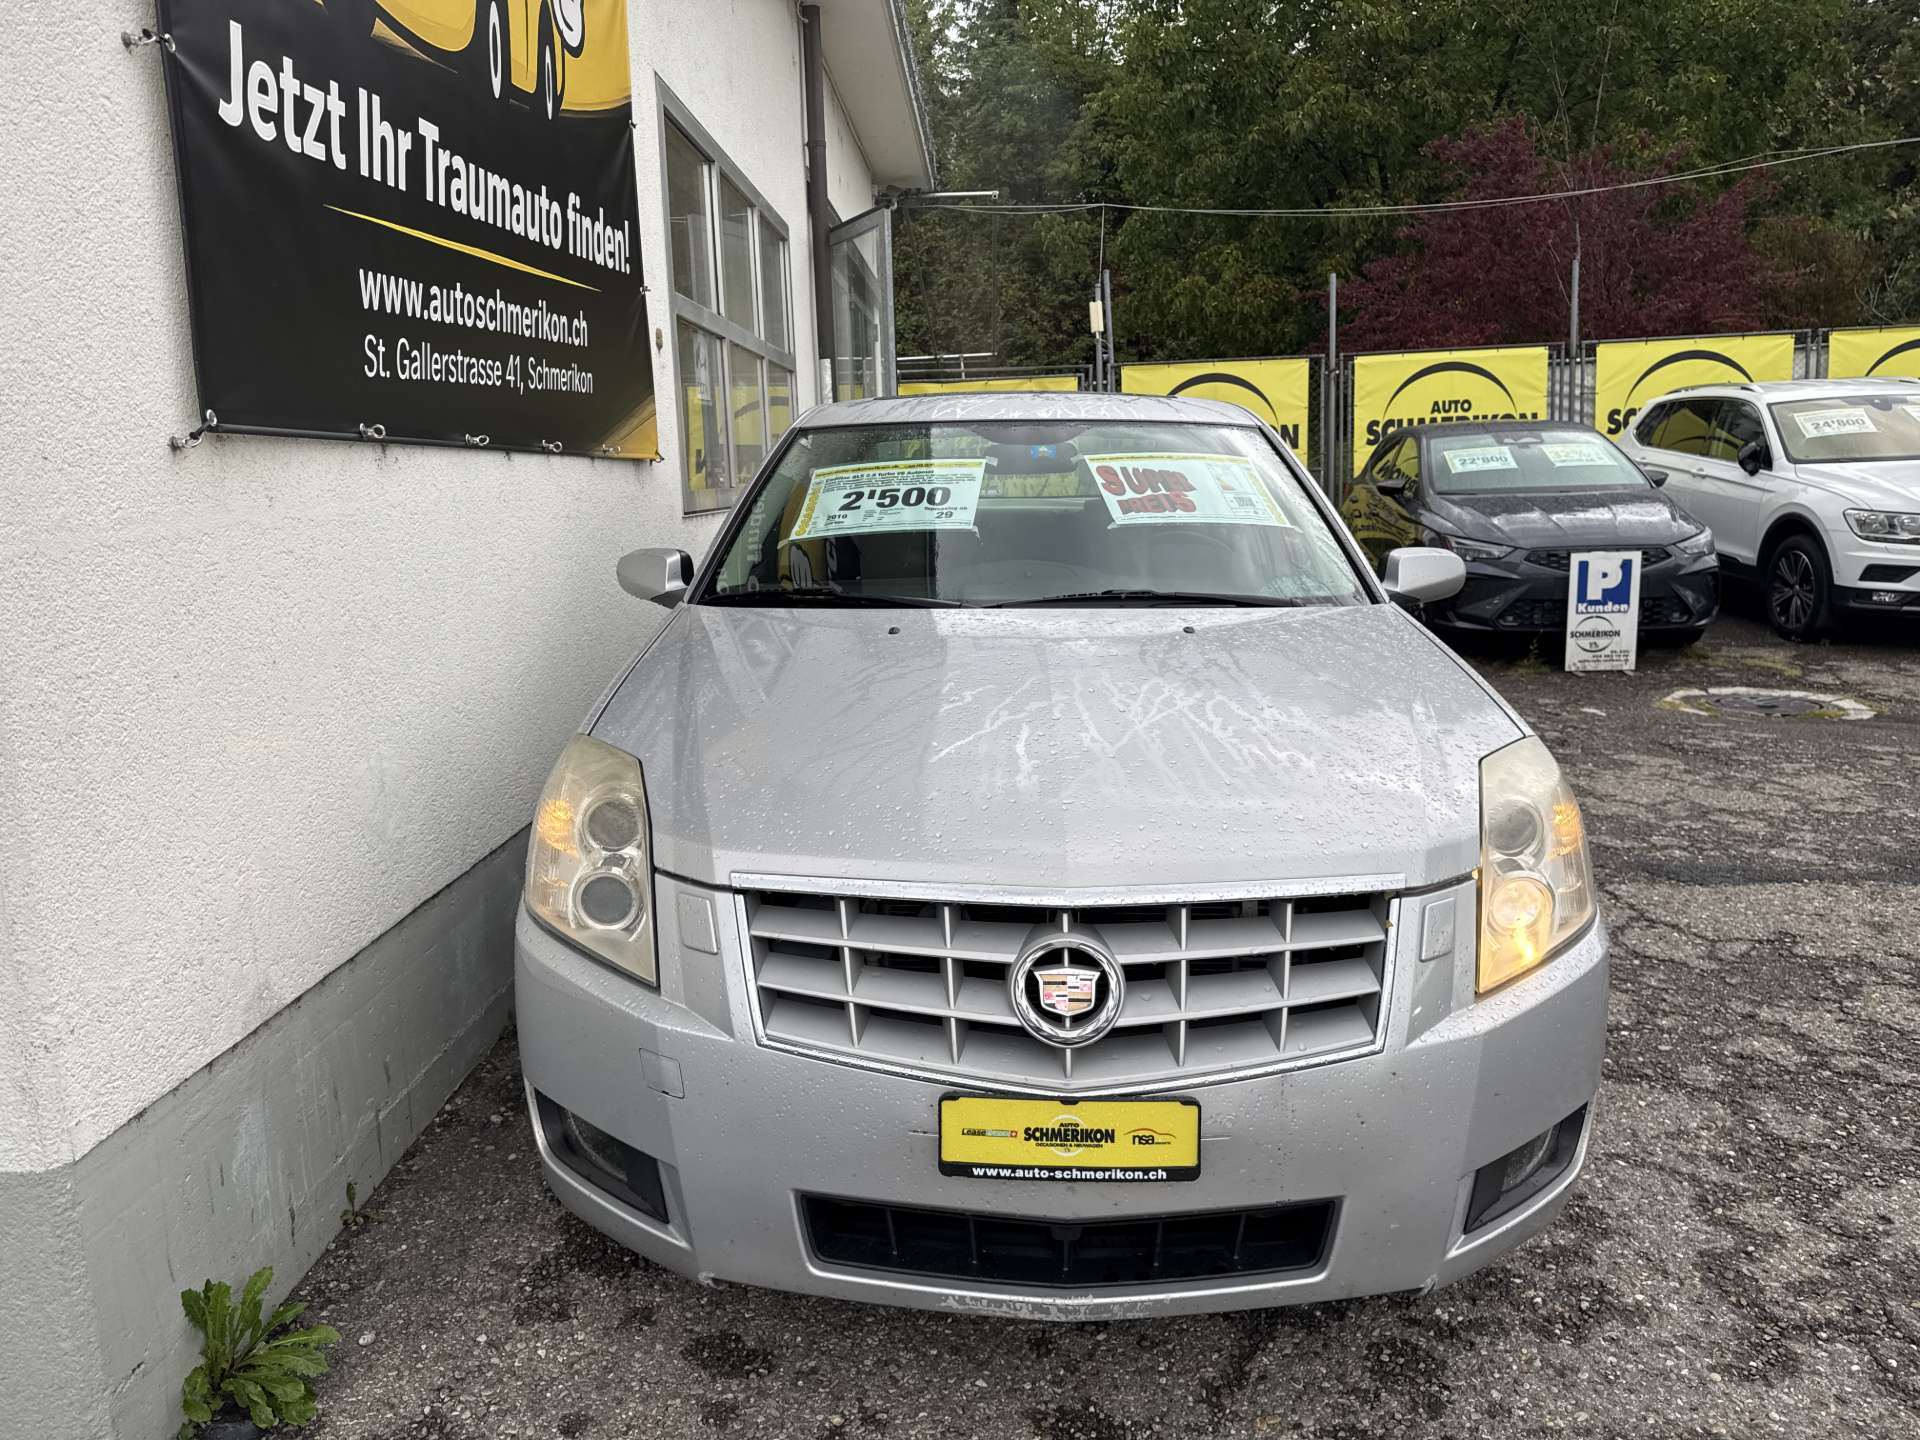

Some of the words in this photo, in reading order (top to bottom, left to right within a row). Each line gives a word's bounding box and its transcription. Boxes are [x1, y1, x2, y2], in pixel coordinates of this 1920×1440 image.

[218, 20, 346, 170] Jetzt
[358, 87, 412, 192] Ihr
[418, 117, 562, 250] Traumauto
[567, 192, 630, 274] finden!
[359, 268, 588, 347] www.autoschmerikon.ch
[364, 334, 390, 378] St.
[396, 337, 502, 386] Gallerstrasse
[505, 354, 523, 395] 41,
[528, 356, 593, 394] Schmerikon
[1430, 399, 1472, 414] AUTO
[838, 486, 951, 512] 2'500
[936, 511, 953, 519] 29
[1577, 601, 1629, 613] Kunden
[1570, 630, 1621, 639] SCHMERIKON
[1024, 1127, 1115, 1144] SCHMERIKON
[1132, 1134, 1154, 1145] nsa
[972, 1167, 1167, 1180] www.auto-schmerikon.ch
